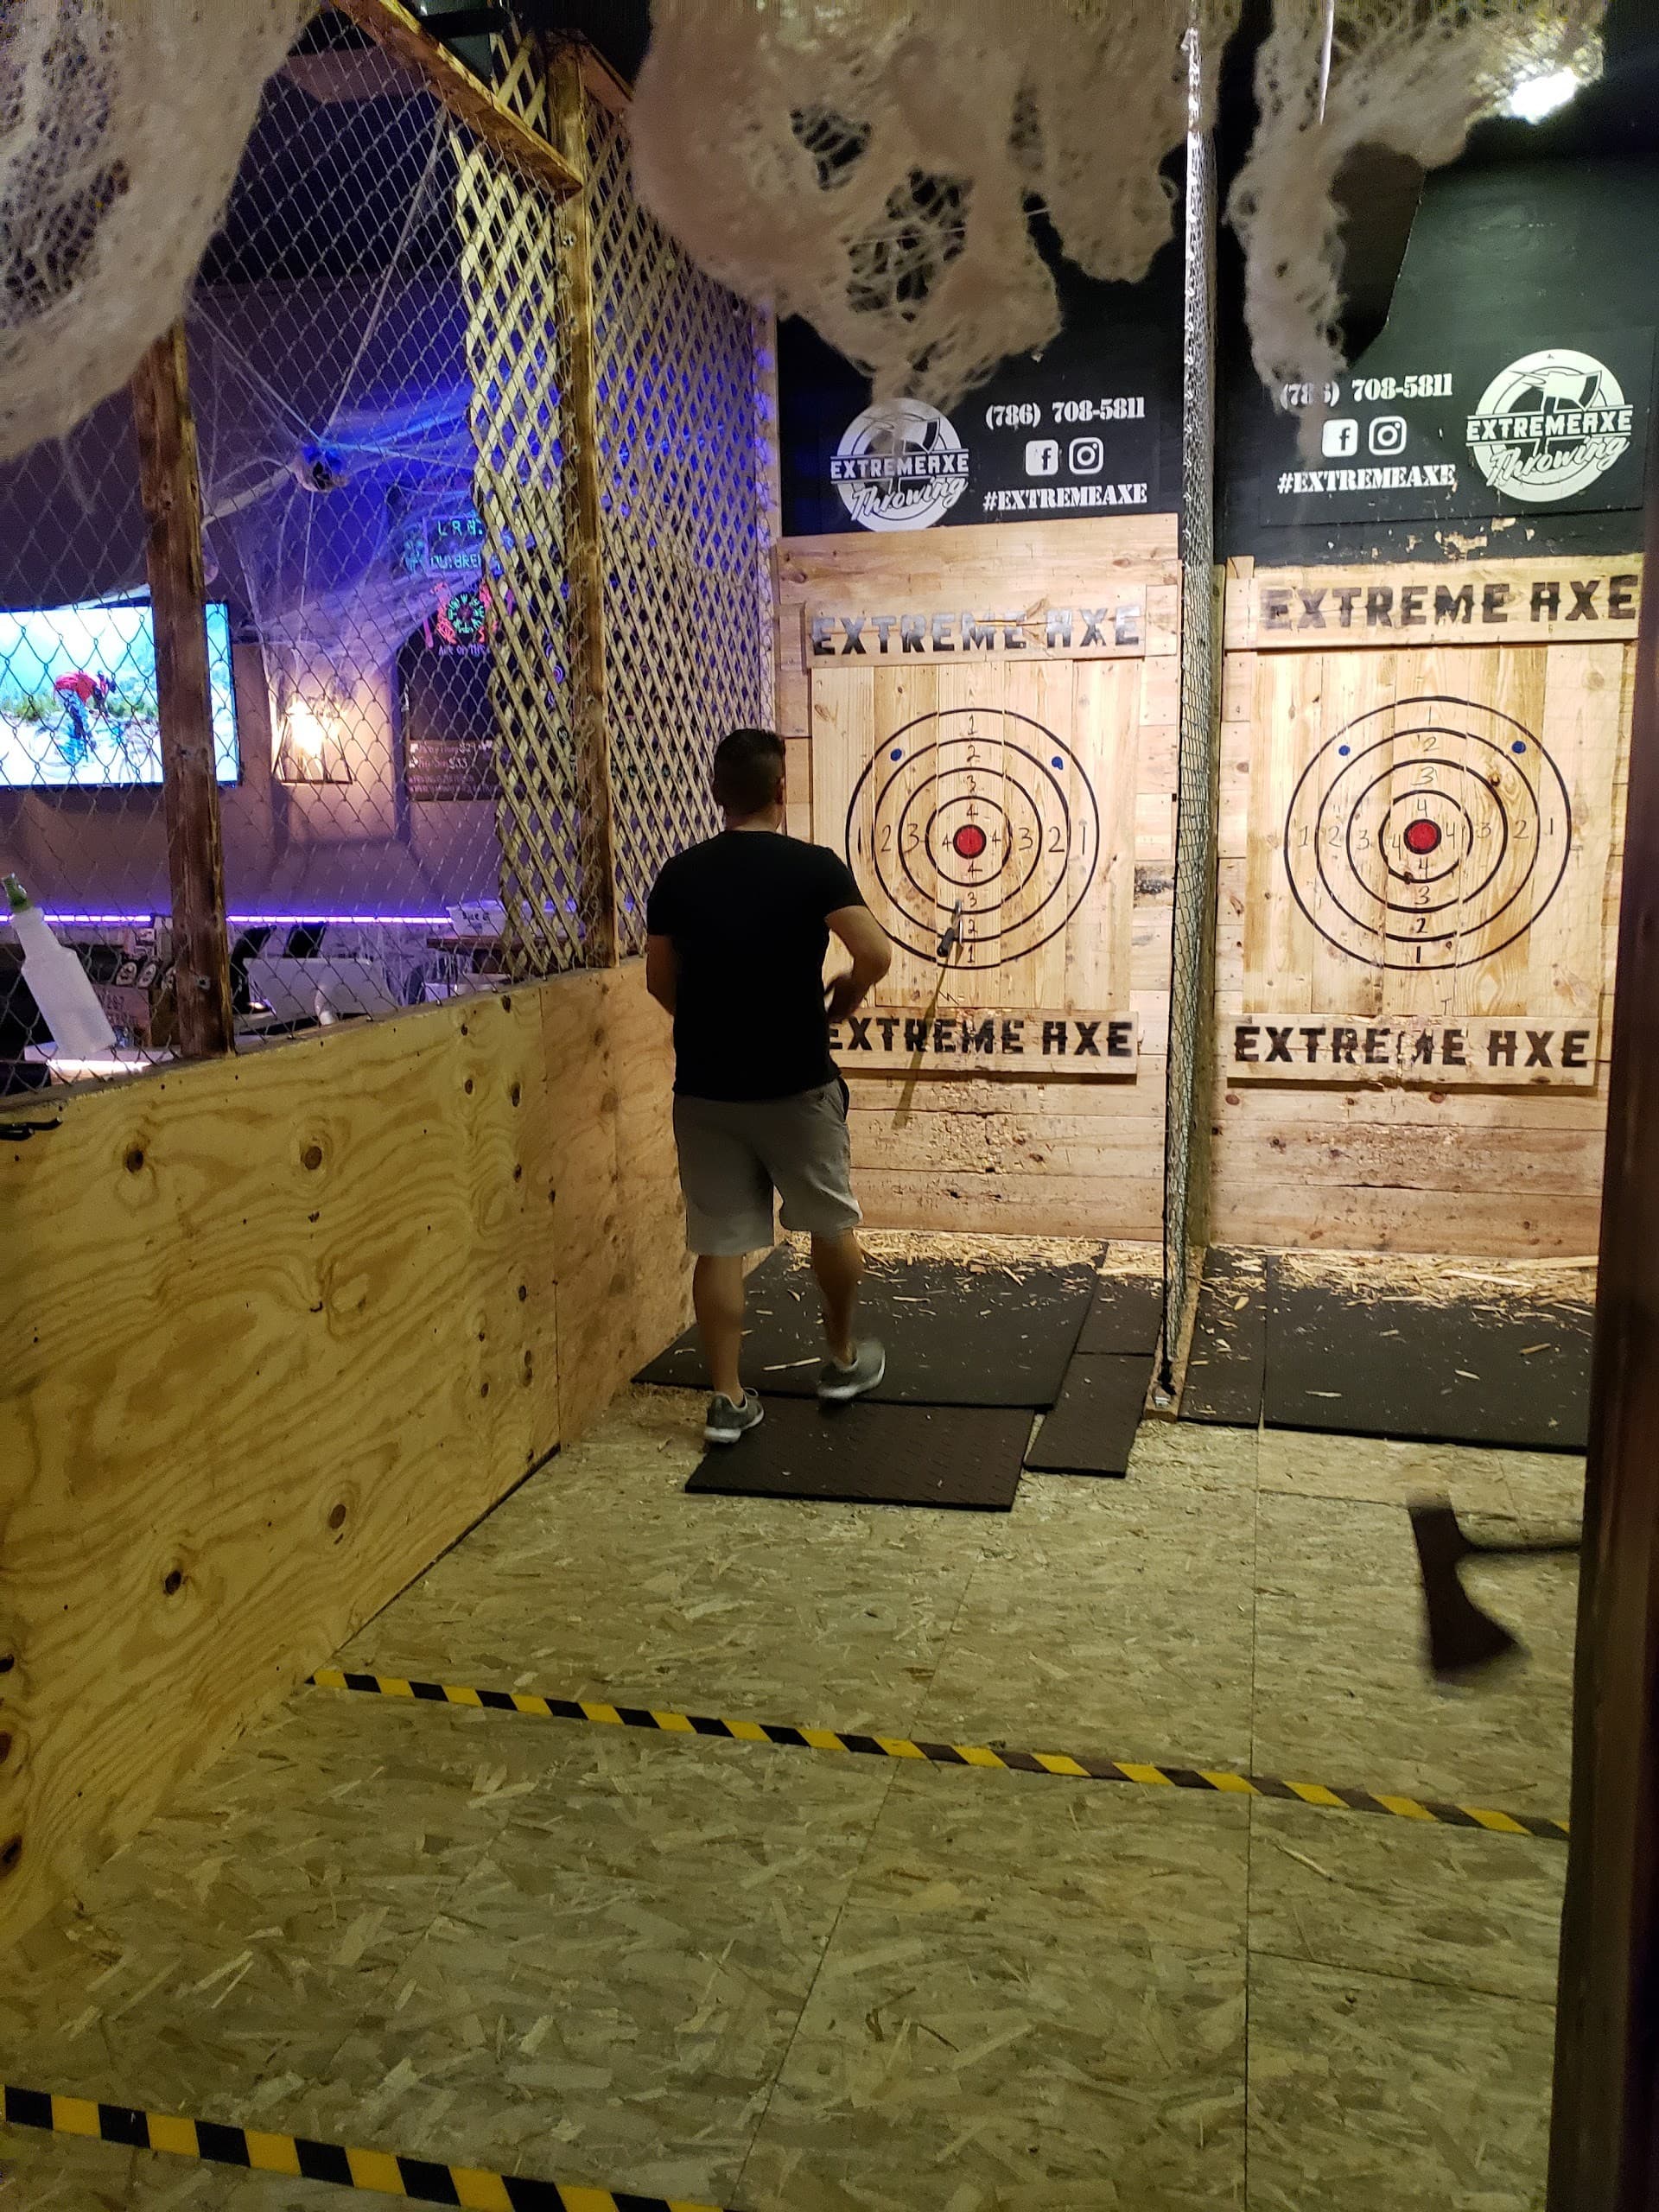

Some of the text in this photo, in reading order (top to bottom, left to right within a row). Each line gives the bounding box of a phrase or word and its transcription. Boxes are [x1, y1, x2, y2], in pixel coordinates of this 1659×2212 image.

[1351, 373, 1452, 402] 708-5811
[986, 397, 1145, 430] (786) 708-5811
[1466, 410, 1633, 442] EXTREMEAXE
[830, 454, 969, 480] EXTREMEAXE
[1486, 435, 1630, 486] Throwing
[1277, 464, 1456, 493] #EXTREMEAXE
[851, 477, 969, 521] Throwing
[982, 483, 1147, 511] #EXTREMEAXE
[1259, 575, 1638, 631] EXTREME AXE
[811, 606, 1141, 656] EXTREME AXE
[967, 715, 976, 734] 1
[967, 745, 980, 761] 2
[967, 775, 977, 792] 3
[966, 804, 978, 817] 4
[880, 824, 892, 852] 2
[905, 823, 919, 853] 3
[942, 834, 952, 851] 4
[991, 830, 1001, 848] 4
[1019, 828, 1033, 850] 3
[1048, 826, 1065, 852] 2
[967, 861, 982, 878] 4
[968, 892, 977, 906] 3
[968, 919, 977, 933] 2
[967, 946, 976, 963] 1
[829, 1016, 1133, 1058] EXTREME AXE
[1235, 1025, 1590, 1068] EXTREME AXE
